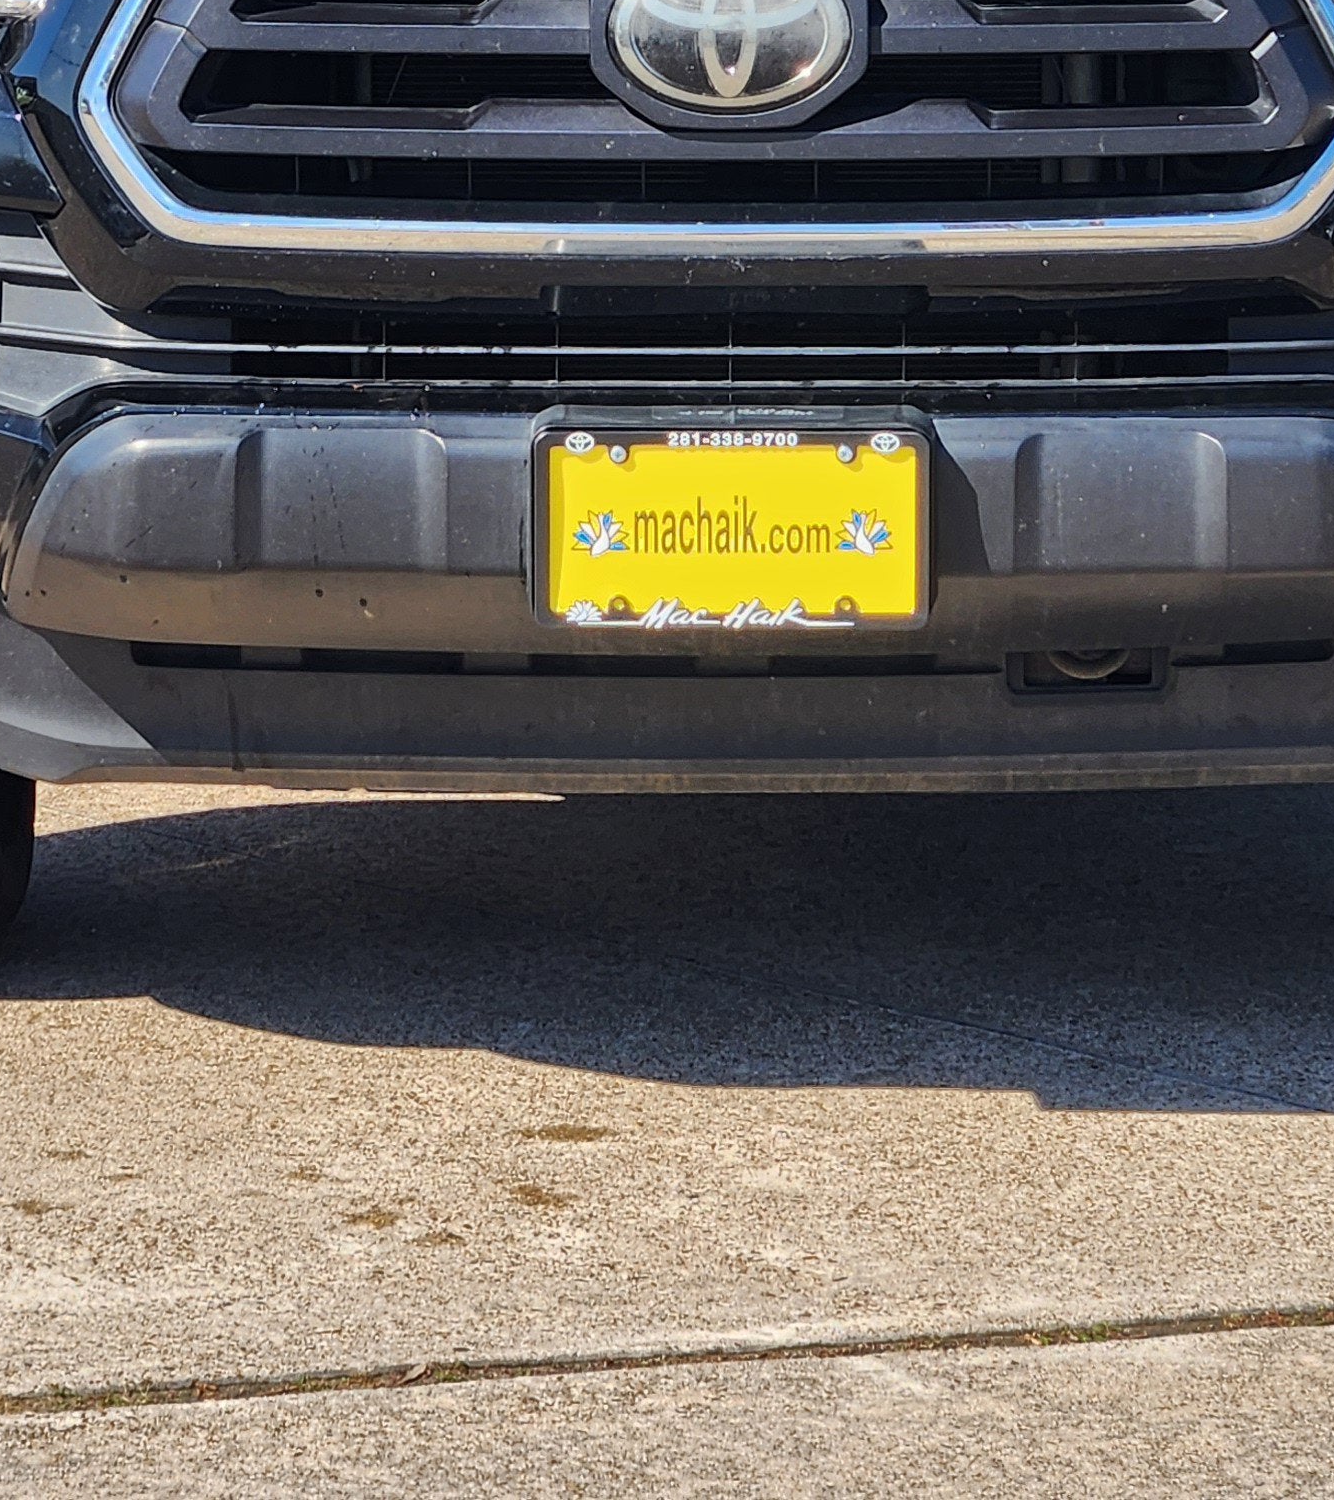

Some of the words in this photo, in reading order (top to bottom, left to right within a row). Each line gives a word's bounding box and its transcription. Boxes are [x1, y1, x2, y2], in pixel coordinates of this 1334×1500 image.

[633, 494, 831, 554] machaik.com
[638, 597, 720, 629] Mac
[722, 597, 807, 629] Haik
